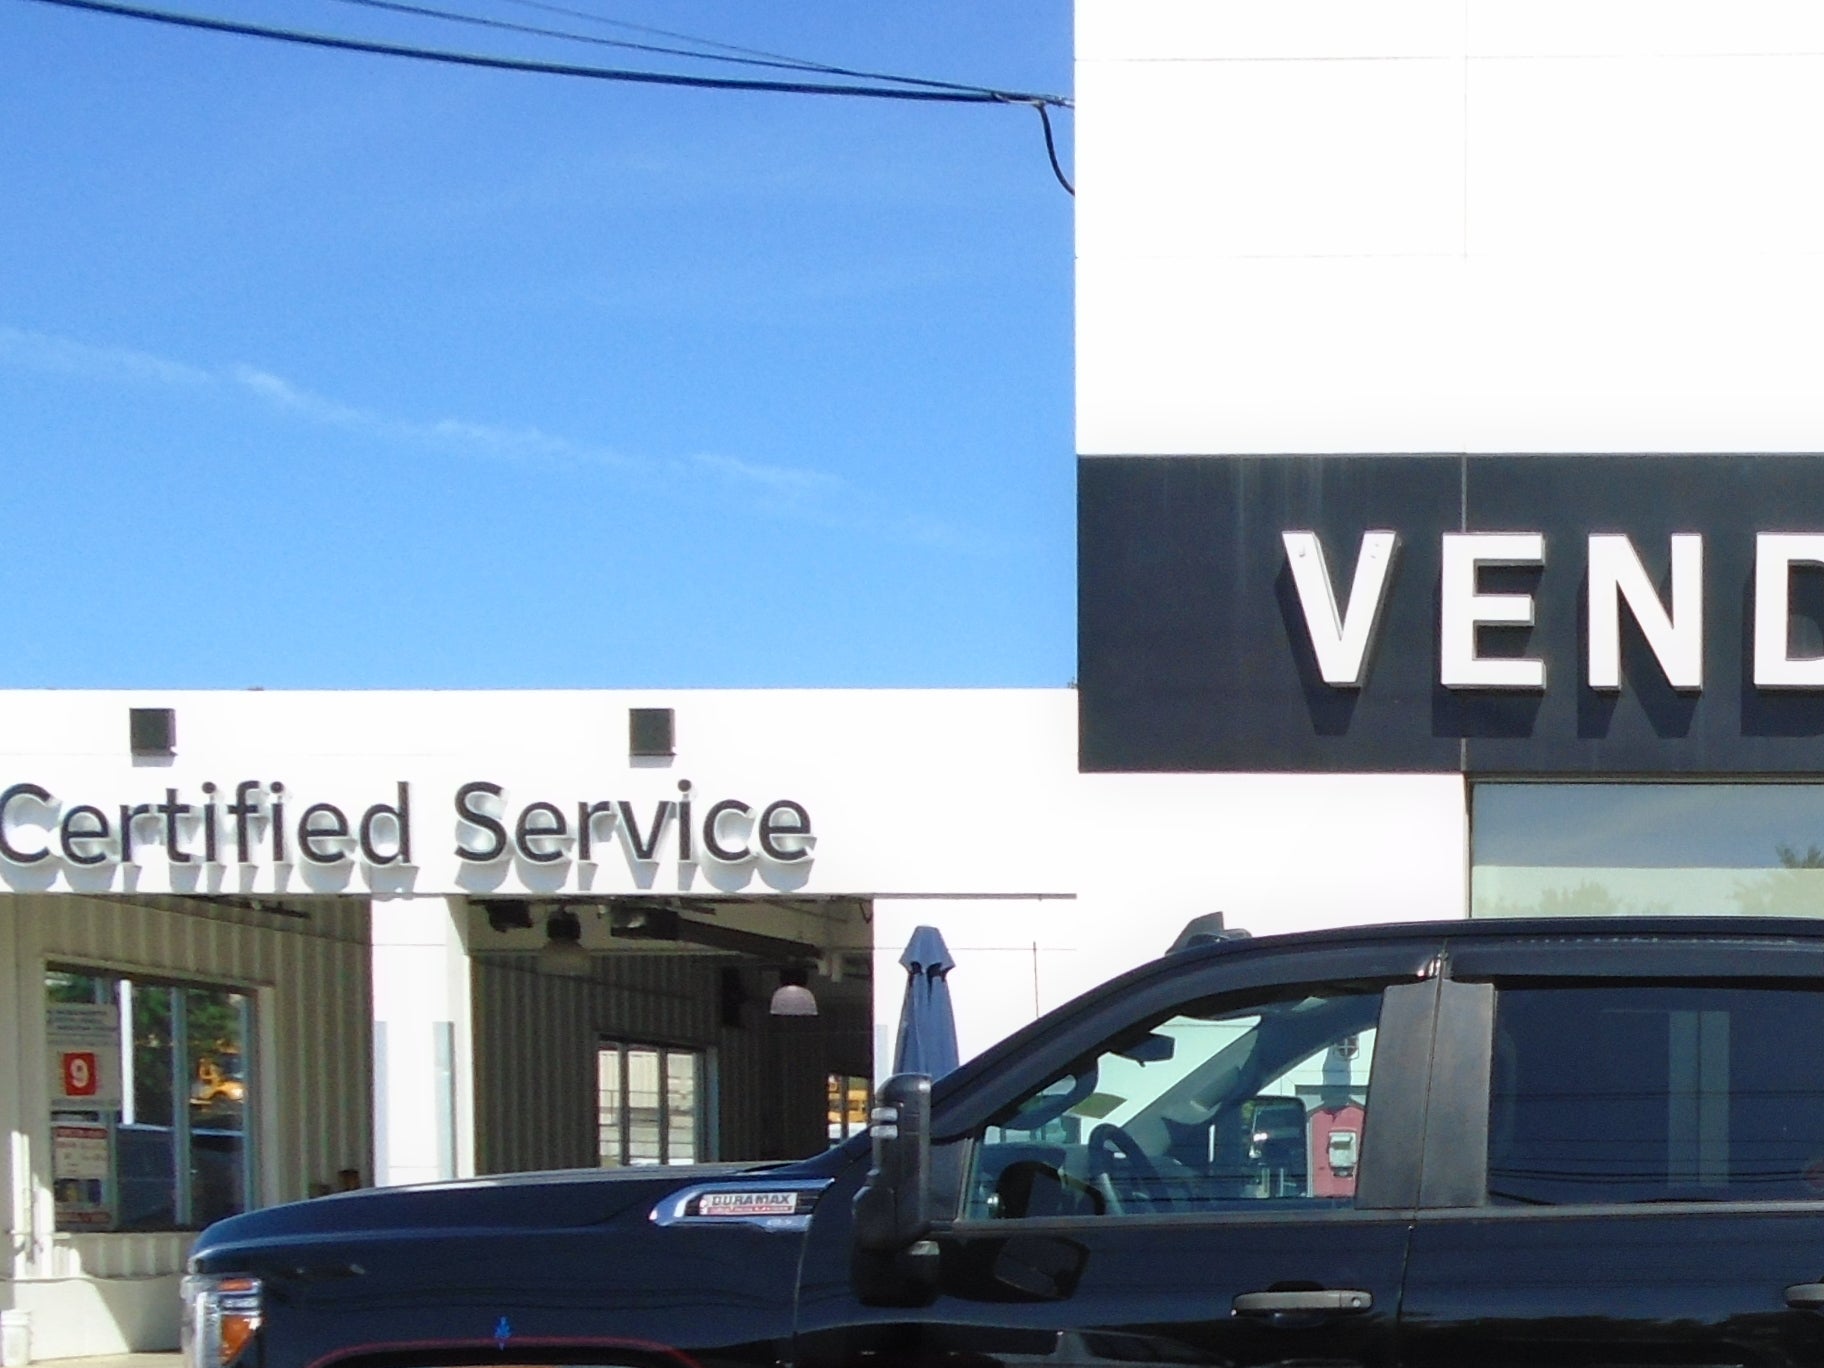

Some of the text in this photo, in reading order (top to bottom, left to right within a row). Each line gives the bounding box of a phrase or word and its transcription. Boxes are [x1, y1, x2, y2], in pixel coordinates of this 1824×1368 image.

[0, 778, 812, 864] Certified Service
[69, 1057, 90, 1088] 9
[711, 1194, 791, 1206] DURAMAX
